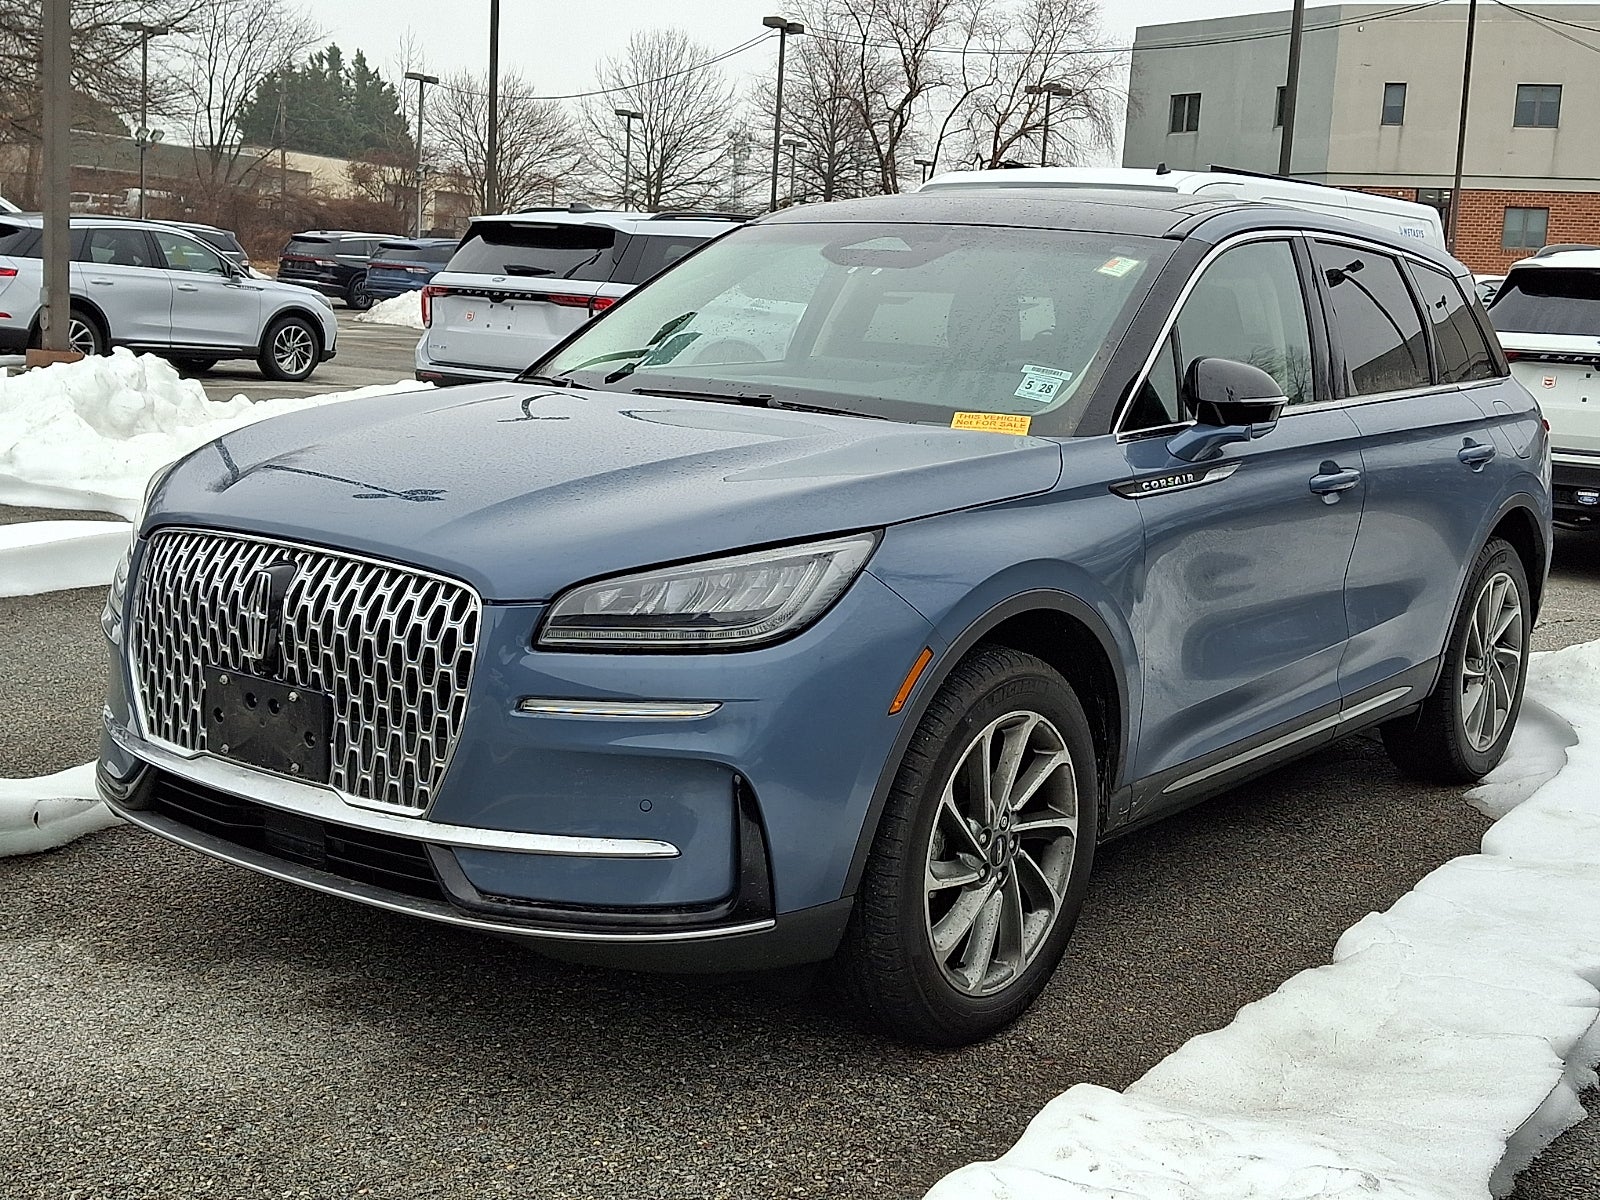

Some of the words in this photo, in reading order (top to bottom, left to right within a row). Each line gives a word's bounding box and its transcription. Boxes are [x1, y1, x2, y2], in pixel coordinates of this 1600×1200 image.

[457, 288, 532, 299] EXPLORER
[1024, 380, 1035, 390] 5
[1038, 383, 1054, 394] 28
[983, 414, 1027, 423] VEHICLE
[999, 421, 1027, 429] SALE
[1141, 473, 1195, 491] CORSAIR
